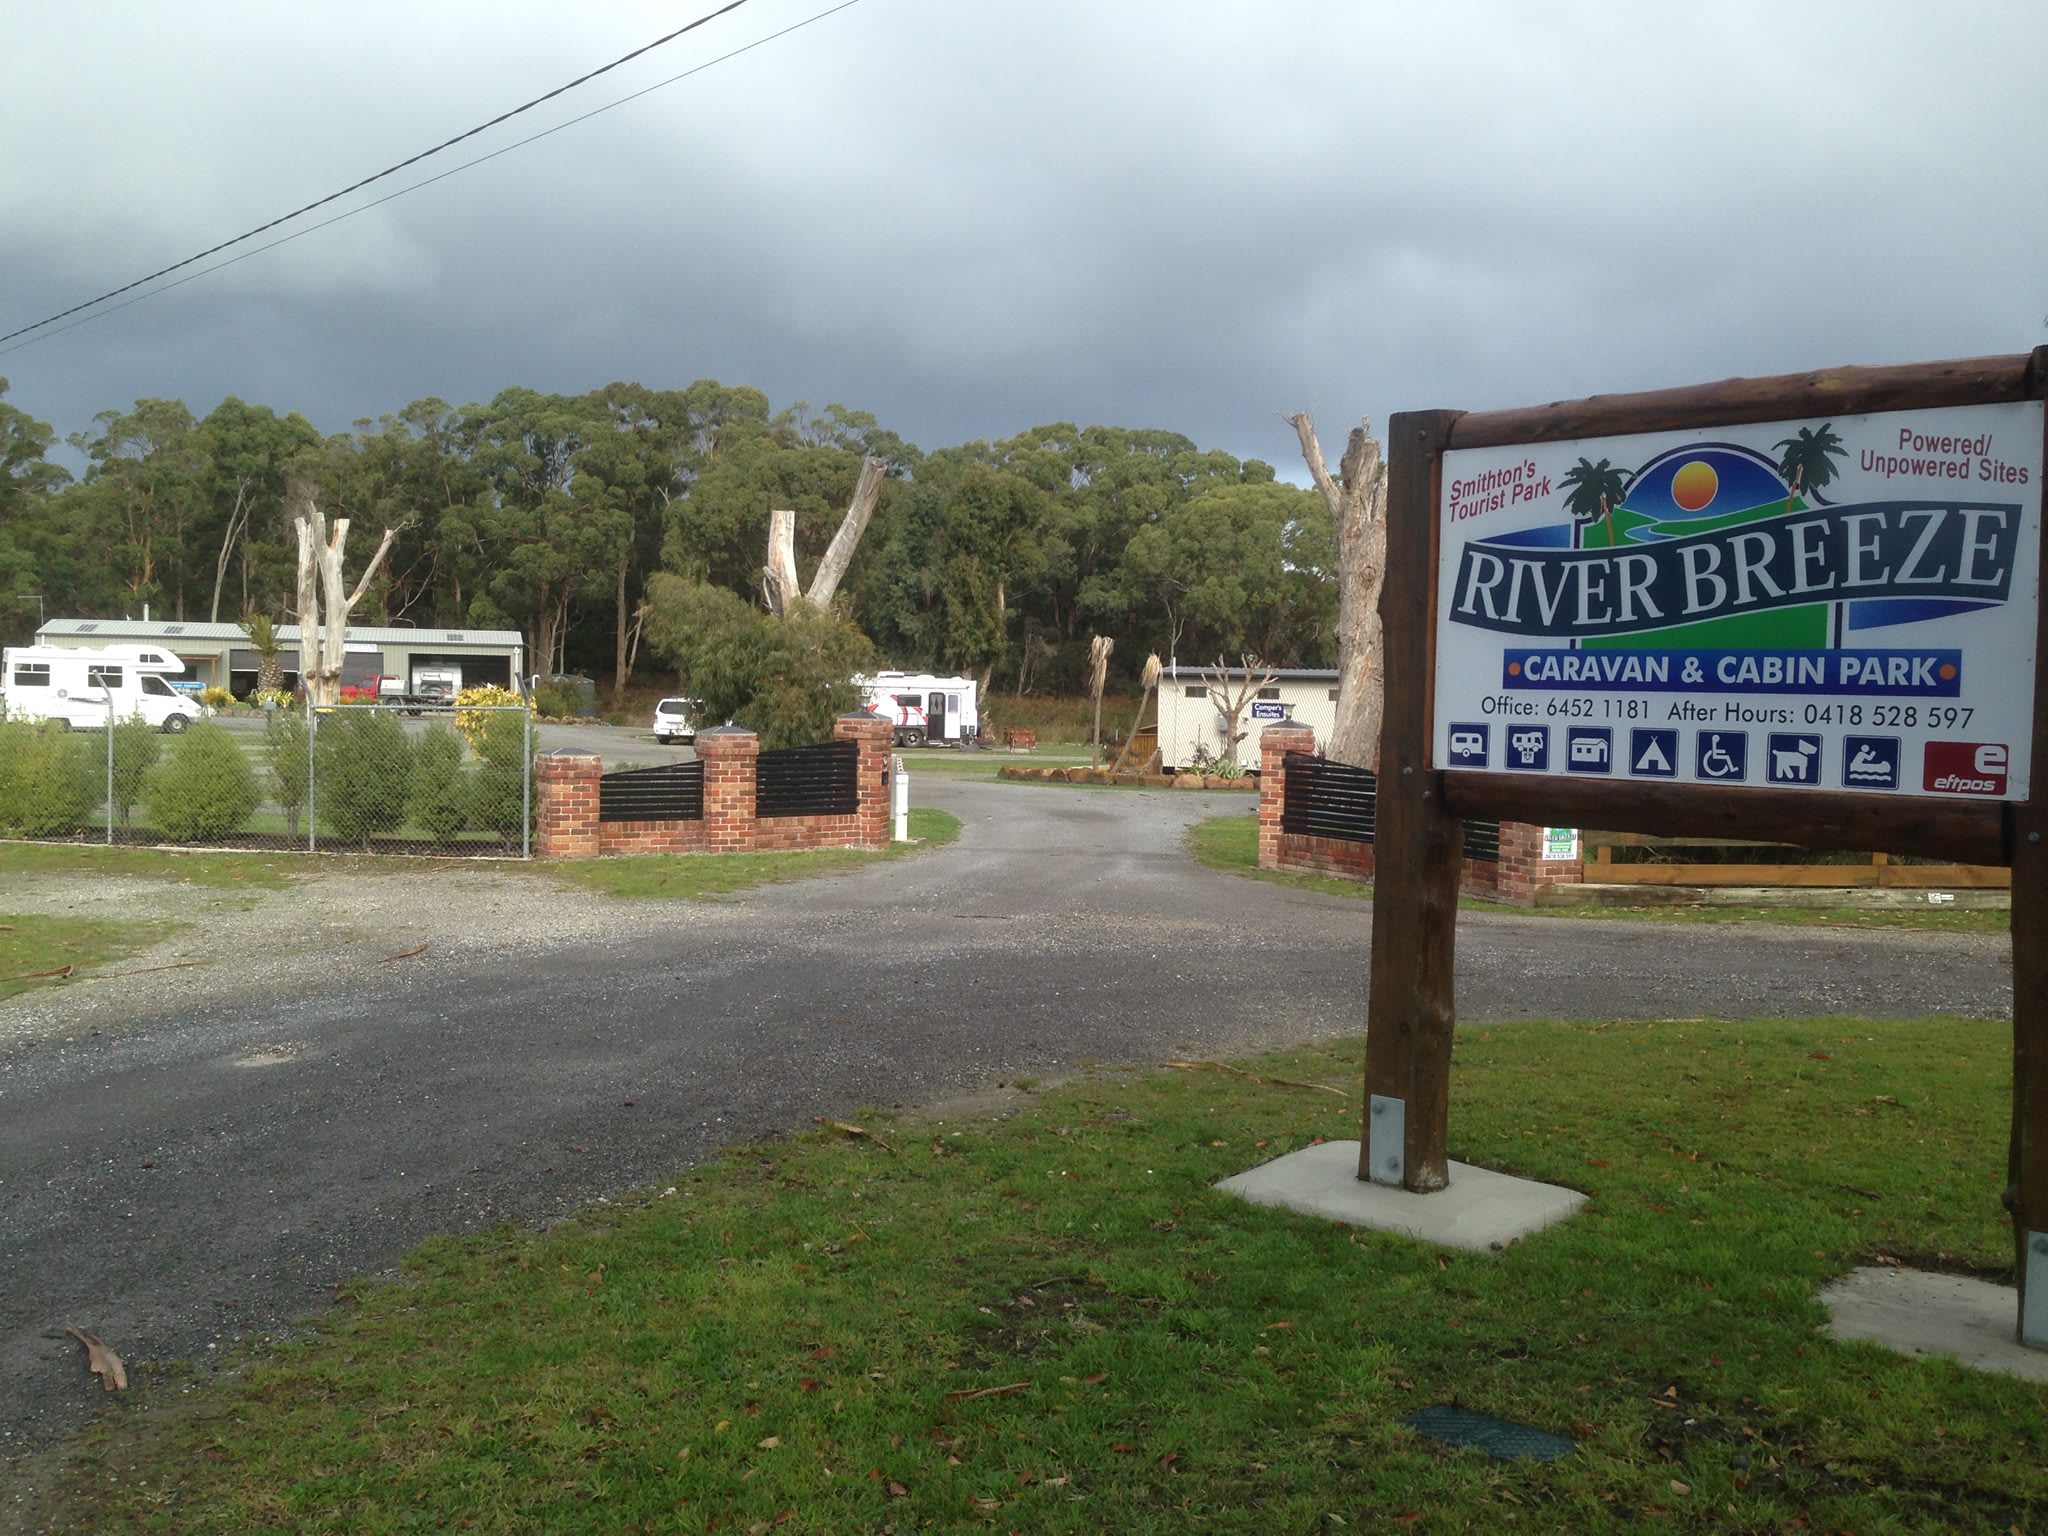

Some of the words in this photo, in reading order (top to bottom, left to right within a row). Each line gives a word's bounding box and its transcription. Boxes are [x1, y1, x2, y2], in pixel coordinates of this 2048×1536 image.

[1899, 427, 1993, 457] Powered/
[1450, 459, 1537, 501] Smithton's
[1860, 449, 1970, 480] Unpowered
[1978, 458, 2030, 485] Sites
[1449, 489, 1506, 522] Tourist
[1511, 476, 1552, 505] Park
[1456, 551, 1665, 627] RIVER
[1676, 508, 2008, 616] BREEZE
[1523, 655, 1670, 683] CARAVAN
[1680, 656, 1705, 684] &
[1717, 656, 1826, 685] CABIN
[1839, 656, 1938, 687] PARK
[1254, 703, 1282, 711] Camper's
[1481, 696, 1539, 716] Office:
[1546, 698, 1594, 718] 6452
[1604, 699, 1649, 719] 1181
[1666, 700, 1717, 721] After
[1725, 702, 1795, 724] Hours:
[1804, 703, 1863, 726] 0418
[1872, 705, 1918, 728] 528
[1927, 707, 1975, 729] 597
[1934, 774, 1996, 792] eftpos
